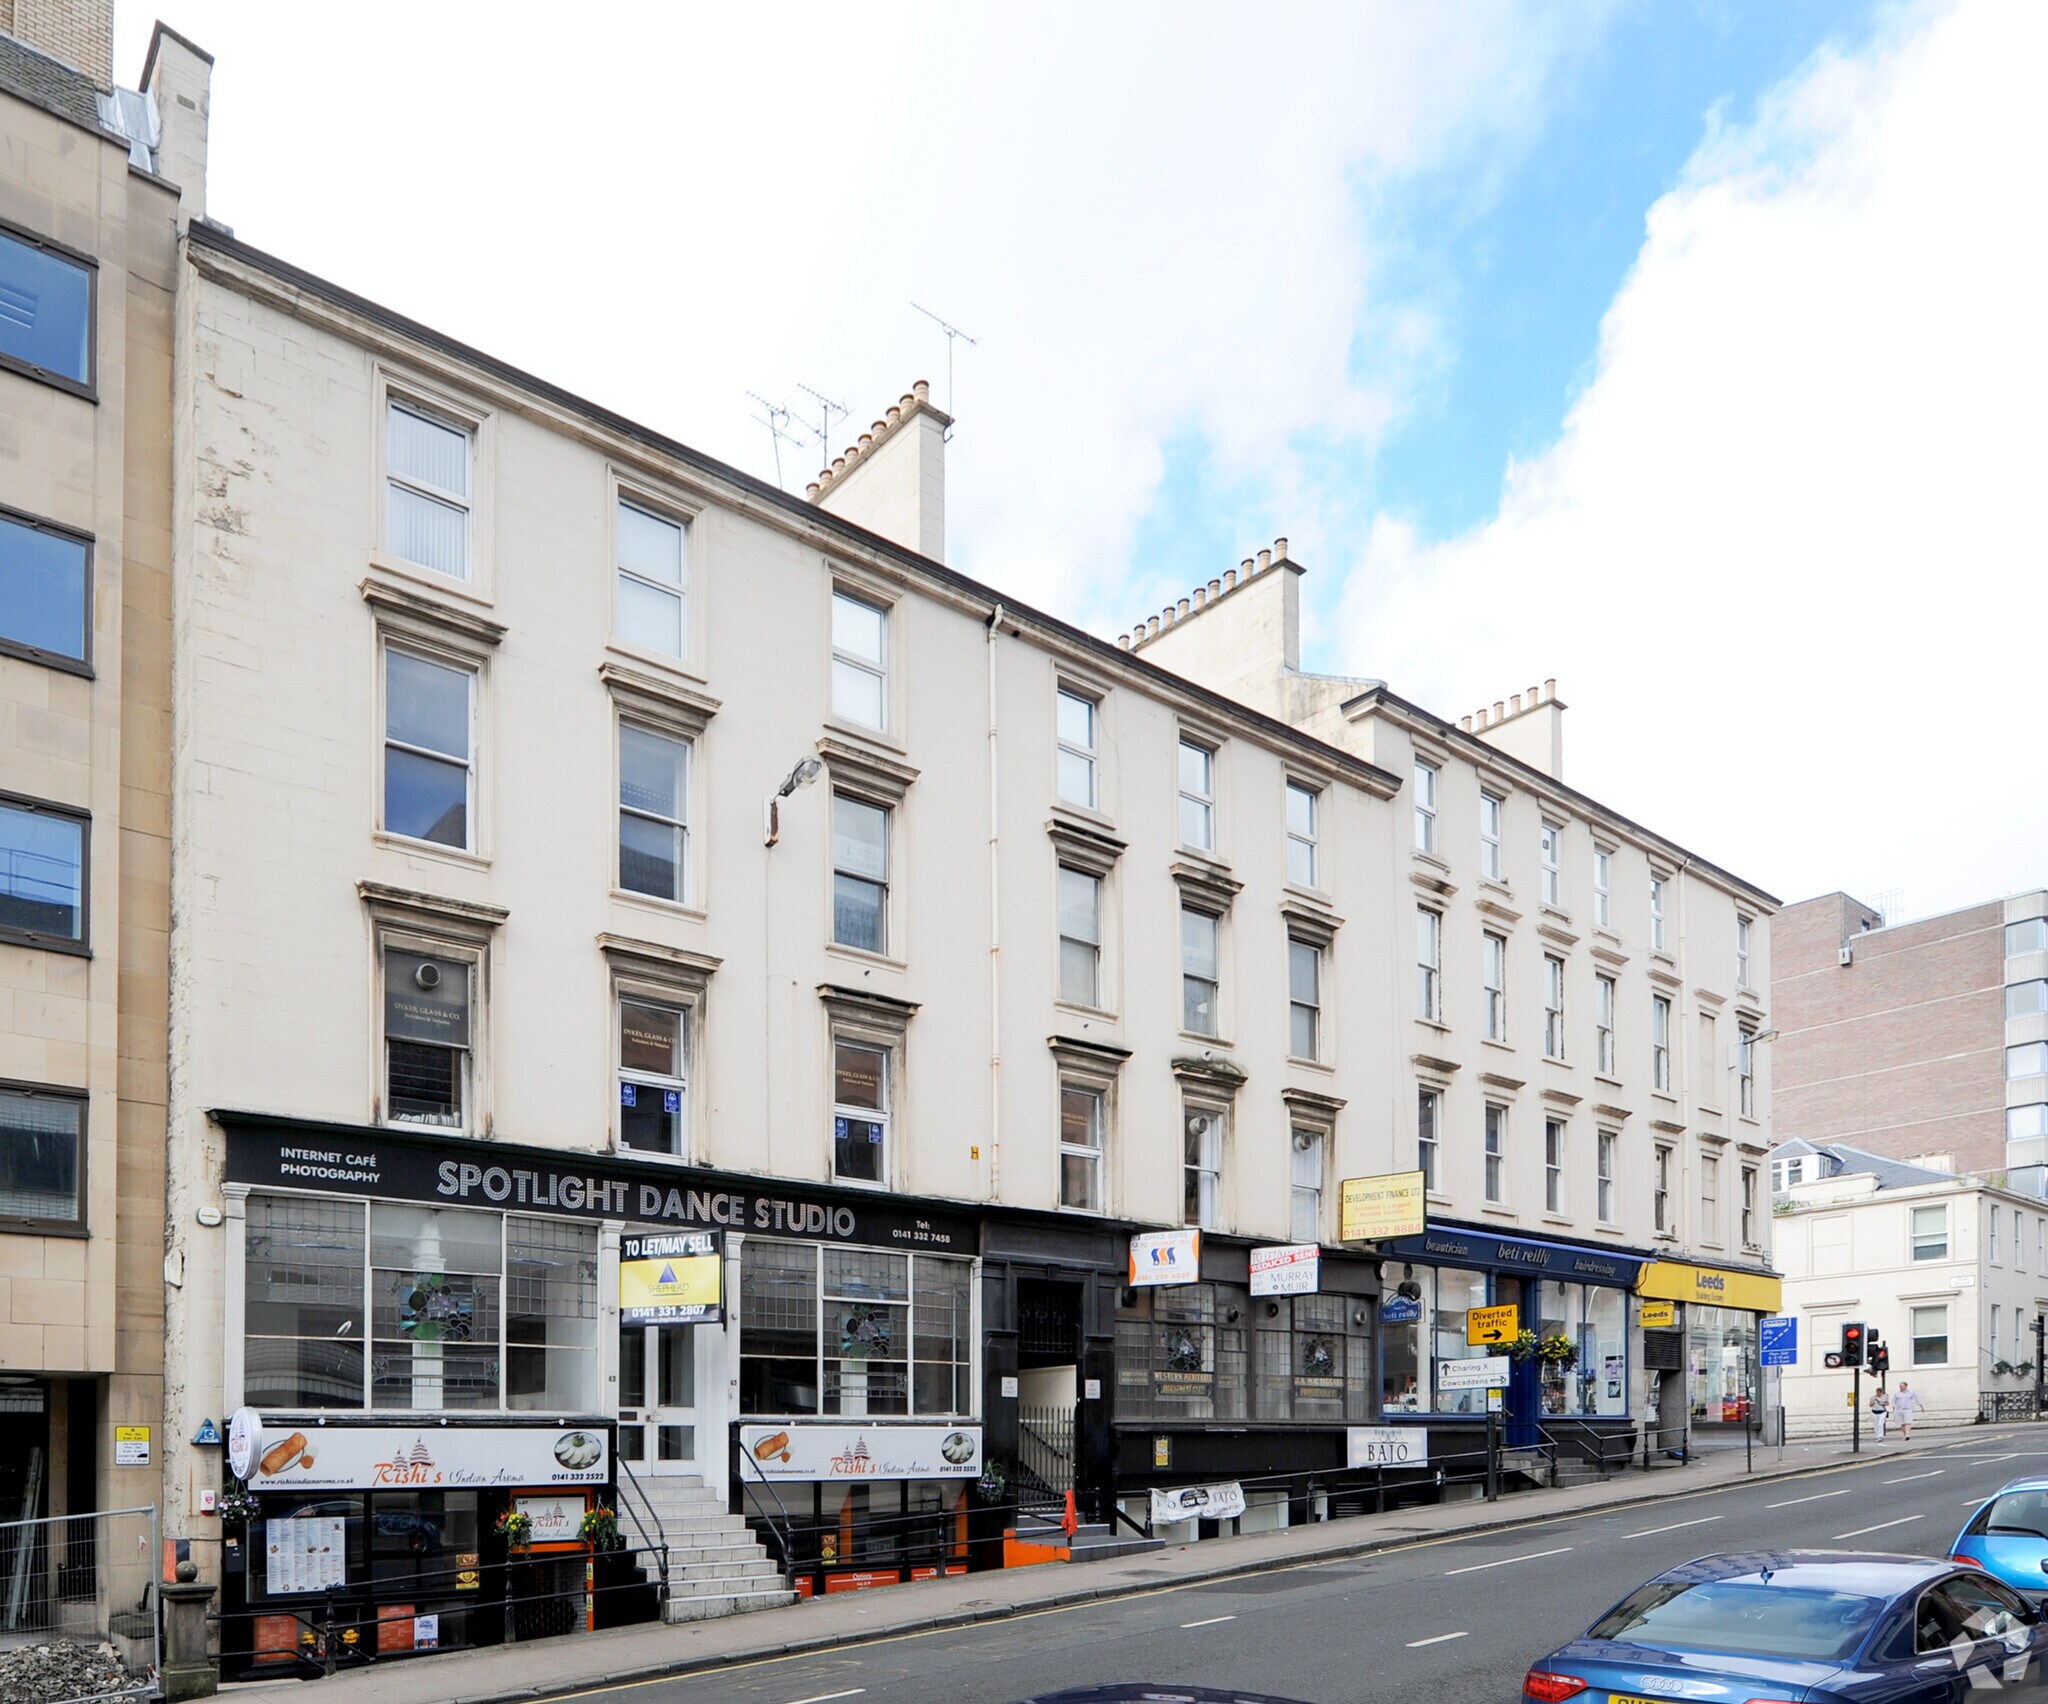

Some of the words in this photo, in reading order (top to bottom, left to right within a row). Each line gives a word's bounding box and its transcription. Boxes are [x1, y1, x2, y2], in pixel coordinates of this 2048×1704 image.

[420, 1007, 441, 1017] GLASS
[644, 1032, 662, 1042] GLASS
[280, 1147, 342, 1163] INTERNET
[345, 1153, 377, 1167] CAFÉ
[280, 1163, 380, 1183] PHOTOGRAPHY
[437, 1160, 629, 1213] SPOTLIGHT
[640, 1184, 745, 1226] DANCE
[754, 1197, 856, 1237] STUDIO
[1345, 1191, 1385, 1204] DEVELOPMENT
[1386, 1188, 1409, 1199] FINANCE
[1411, 1187, 1421, 1197] LTD
[916, 1220, 930, 1230] Tel:
[1343, 1228, 1366, 1238] 0141
[1371, 1226, 1389, 1236] 332
[1394, 1223, 1421, 1234] 8884
[892, 1229, 911, 1239] 0141
[913, 1231, 929, 1241] 332
[625, 1239, 640, 1256] TO
[641, 1236, 687, 1256] LET/MAY
[688, 1234, 714, 1253] SELL
[1251, 1256, 1292, 1273] REDUCED
[1294, 1250, 1317, 1262] RENT
[1253, 1252, 1262, 1262] TO
[1425, 1238, 1468, 1256] beautician
[1497, 1243, 1519, 1261] beti
[1521, 1247, 1550, 1268] reilly
[1574, 1259, 1616, 1277] hairdressing
[1270, 1271, 1314, 1282] MURRAY
[1696, 1270, 1725, 1291] Leeds
[648, 1283, 690, 1294] SHEPHERD
[1280, 1282, 1308, 1292] MUIR
[631, 1307, 655, 1318] 0141
[658, 1306, 677, 1317] 331
[680, 1304, 706, 1316] 2807
[1398, 1309, 1418, 1318] reilly
[1472, 1309, 1513, 1320] Diverted
[1642, 1311, 1669, 1319] Leeds
[1478, 1319, 1507, 1328] traffic
[1452, 1364, 1481, 1373] Charing
[1441, 1378, 1488, 1387] Cowcaddens
[1367, 1444, 1408, 1464] BAJO
[829, 1456, 876, 1476] Rishi's
[879, 1461, 906, 1475] Indian
[372, 1462, 442, 1486] Rishi's
[450, 1468, 486, 1484] Indian
[490, 1468, 524, 1484] Aroma
[552, 1473, 568, 1481] 0141
[260, 1477, 354, 1485] www.rishisindianaroma.co.uk
[379, 1514, 421, 1529] OPEN
[535, 1515, 569, 1529] Rishi's
